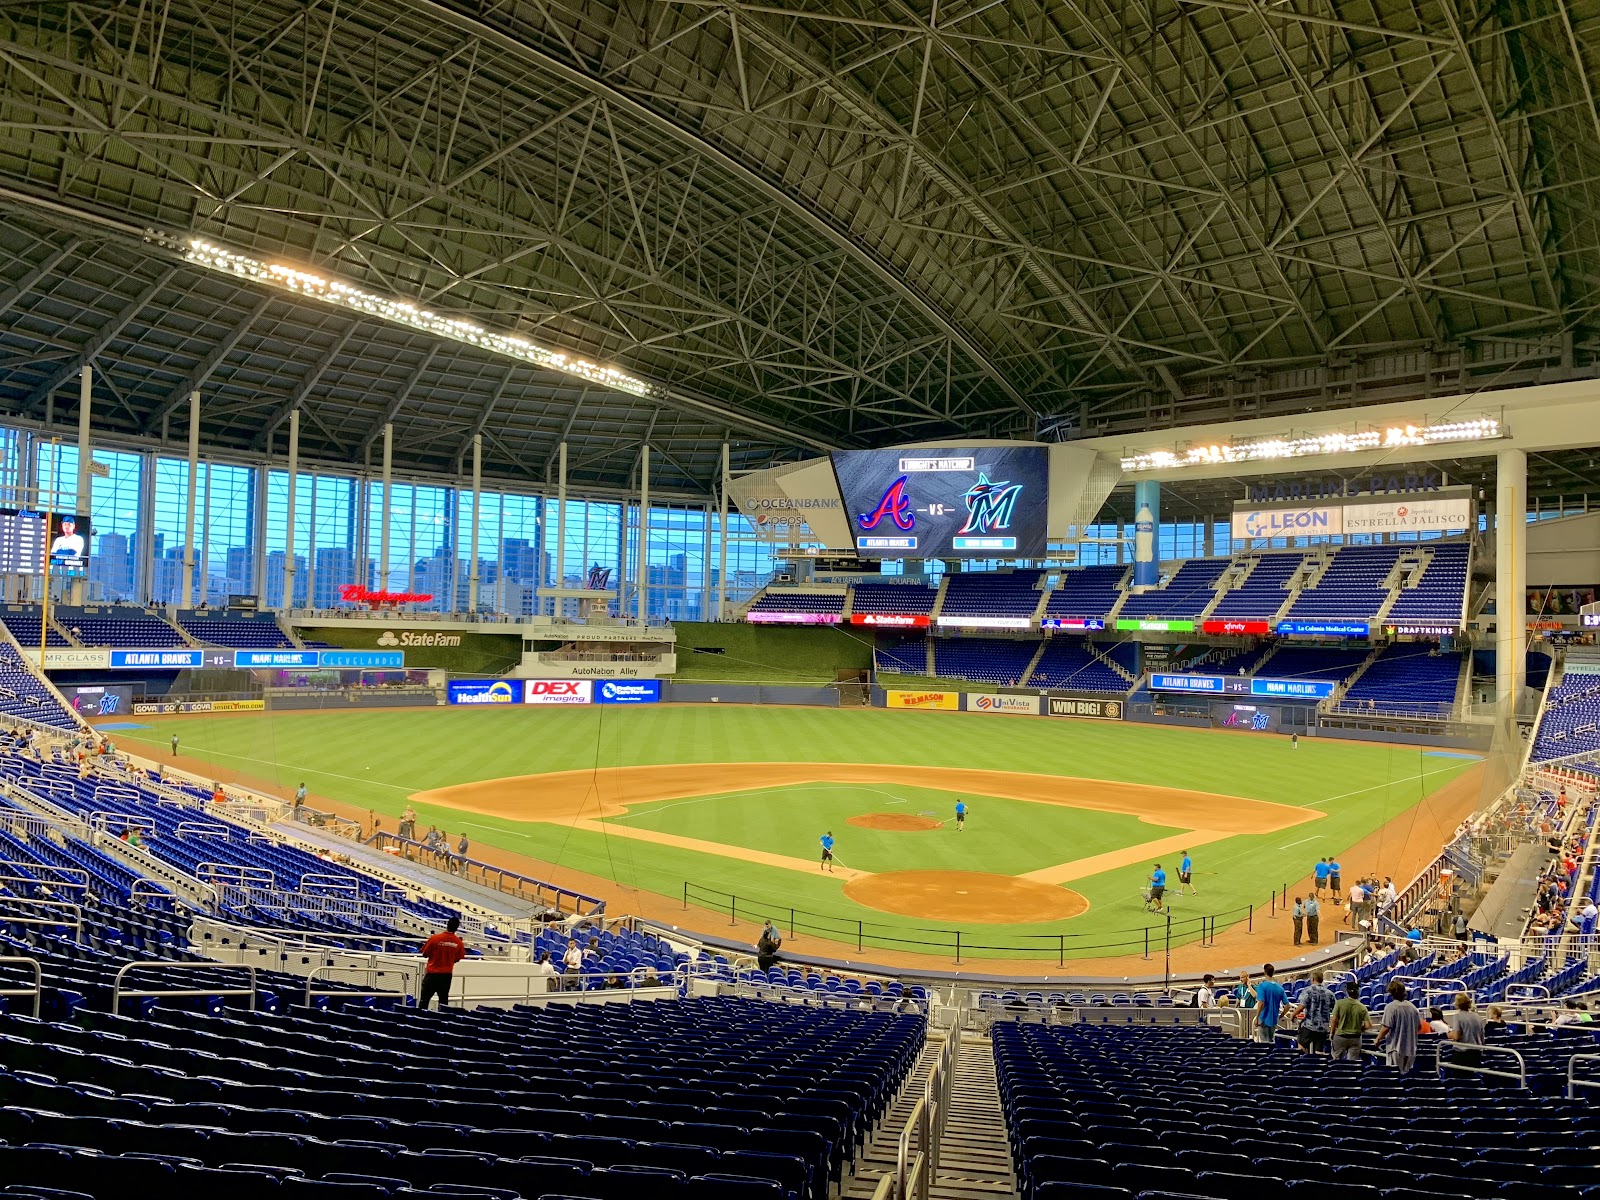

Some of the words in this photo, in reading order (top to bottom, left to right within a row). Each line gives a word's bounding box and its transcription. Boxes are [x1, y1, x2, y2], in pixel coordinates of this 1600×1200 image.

[1250, 480, 1360, 503] MARLINS
[1370, 473, 1440, 496] PARK
[761, 499, 839, 508] OCEANBANK
[929, 504, 944, 515] VS
[771, 515, 805, 526] pepsi
[1270, 511, 1328, 529] LEON
[1347, 516, 1407, 528] ESTRELLA
[1411, 514, 1466, 525] JALISCO
[831, 577, 863, 585] AQUAFINA
[889, 577, 921, 585] AQUAFINA
[1584, 615, 1600, 626] 6:0
[1224, 623, 1246, 631] xfinity
[125, 654, 160, 664] ATLANTA
[161, 654, 192, 664] BRAVES
[214, 657, 224, 665] VS
[321, 653, 401, 665] CLEVELANDER
[572, 667, 615, 675] AutoNation
[620, 668, 638, 676] Alley
[531, 682, 580, 695] DEX
[1162, 677, 1188, 688] ATLANTA
[1189, 679, 1214, 689] BRAVES
[1267, 682, 1285, 692] MIAMI
[1287, 683, 1316, 694] MARLINS
[457, 691, 512, 703] HealthSun
[543, 695, 586, 703] imaging
[992, 696, 1030, 709] UniVista
[1053, 701, 1076, 713] WIN
[1079, 703, 1101, 715] BIG!
